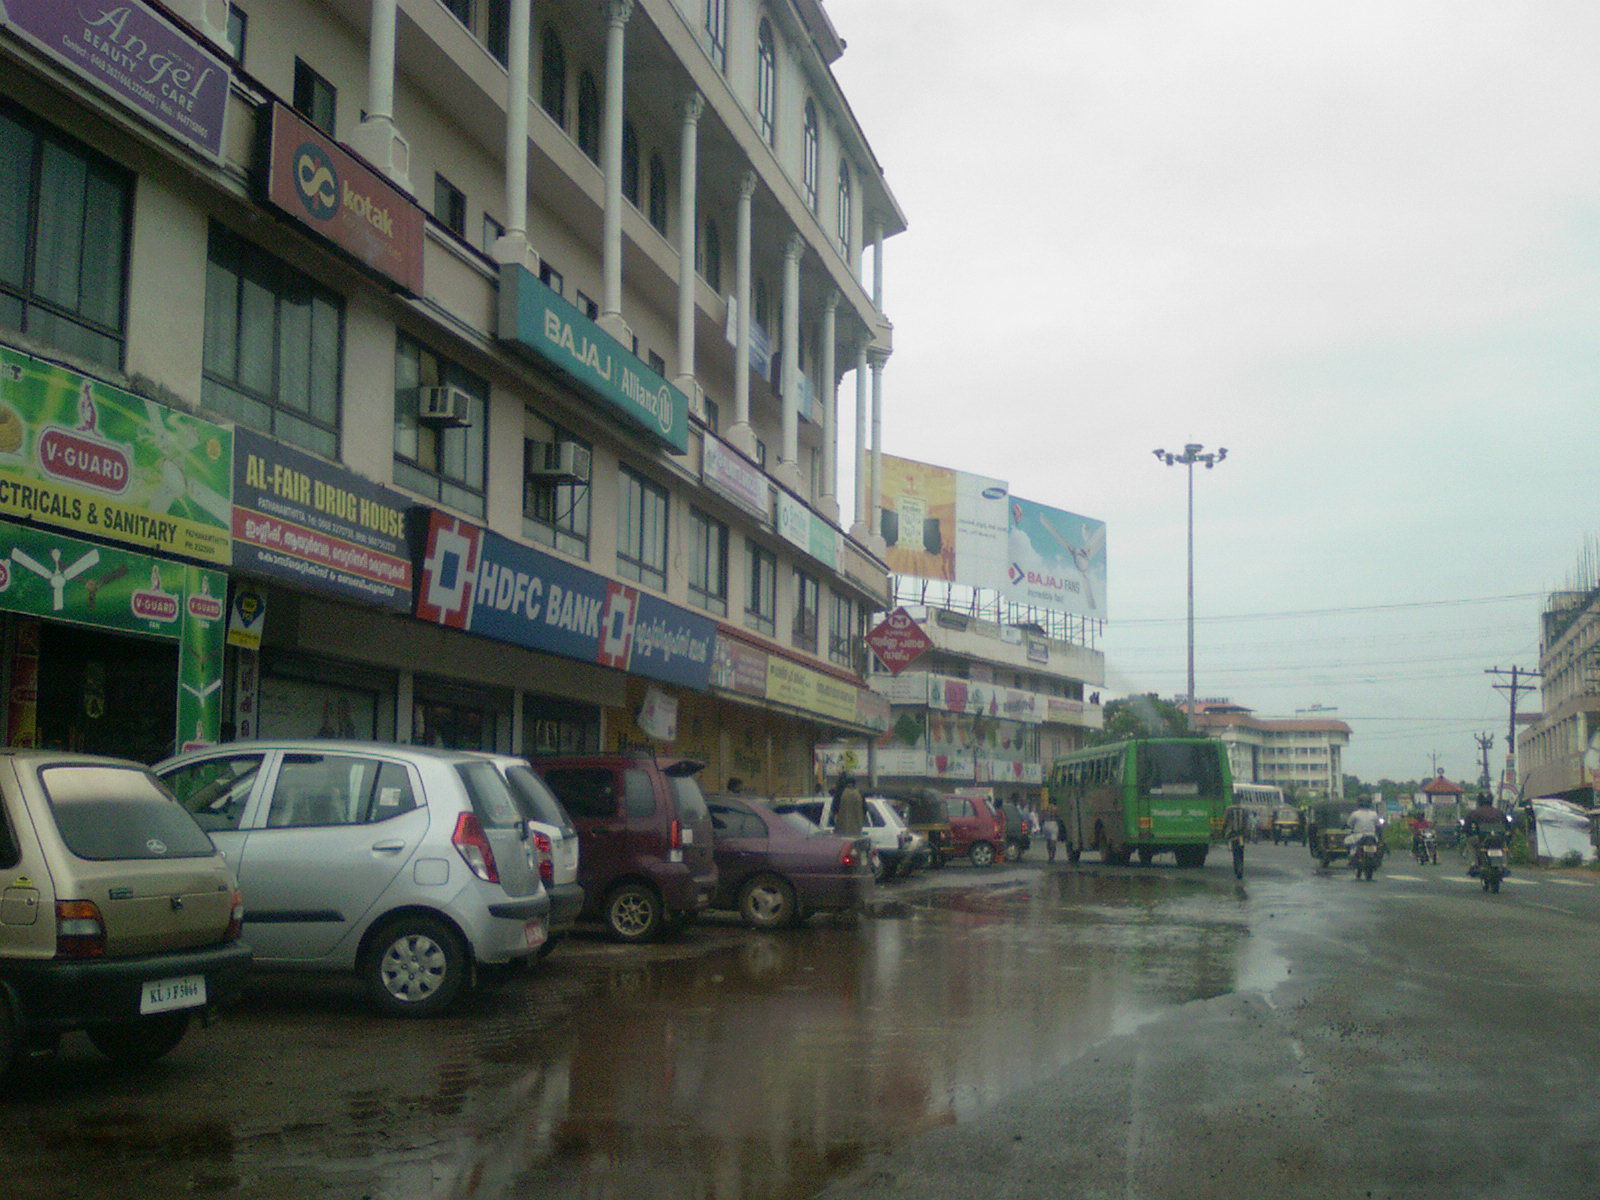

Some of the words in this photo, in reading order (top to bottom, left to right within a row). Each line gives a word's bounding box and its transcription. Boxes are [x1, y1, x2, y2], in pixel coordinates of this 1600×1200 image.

[78, 7, 214, 99] Angel
[84, 28, 137, 73] BEAUTY
[161, 82, 194, 113] CARE
[342, 179, 394, 239] kotak
[544, 308, 612, 381] BAJAJ
[621, 366, 658, 415] Allianz
[46, 440, 125, 481] V-GUARD
[87, 502, 98, 524] &
[103, 506, 178, 544] SANITARY
[246, 454, 311, 505] AL-FAIR
[314, 479, 357, 523] DRUG
[359, 497, 406, 540] HOUSE
[136, 597, 175, 613] V-GUARD
[477, 559, 544, 621] HDFC
[545, 584, 603, 639] BANK
[1027, 570, 1063, 590] BAJAJ
